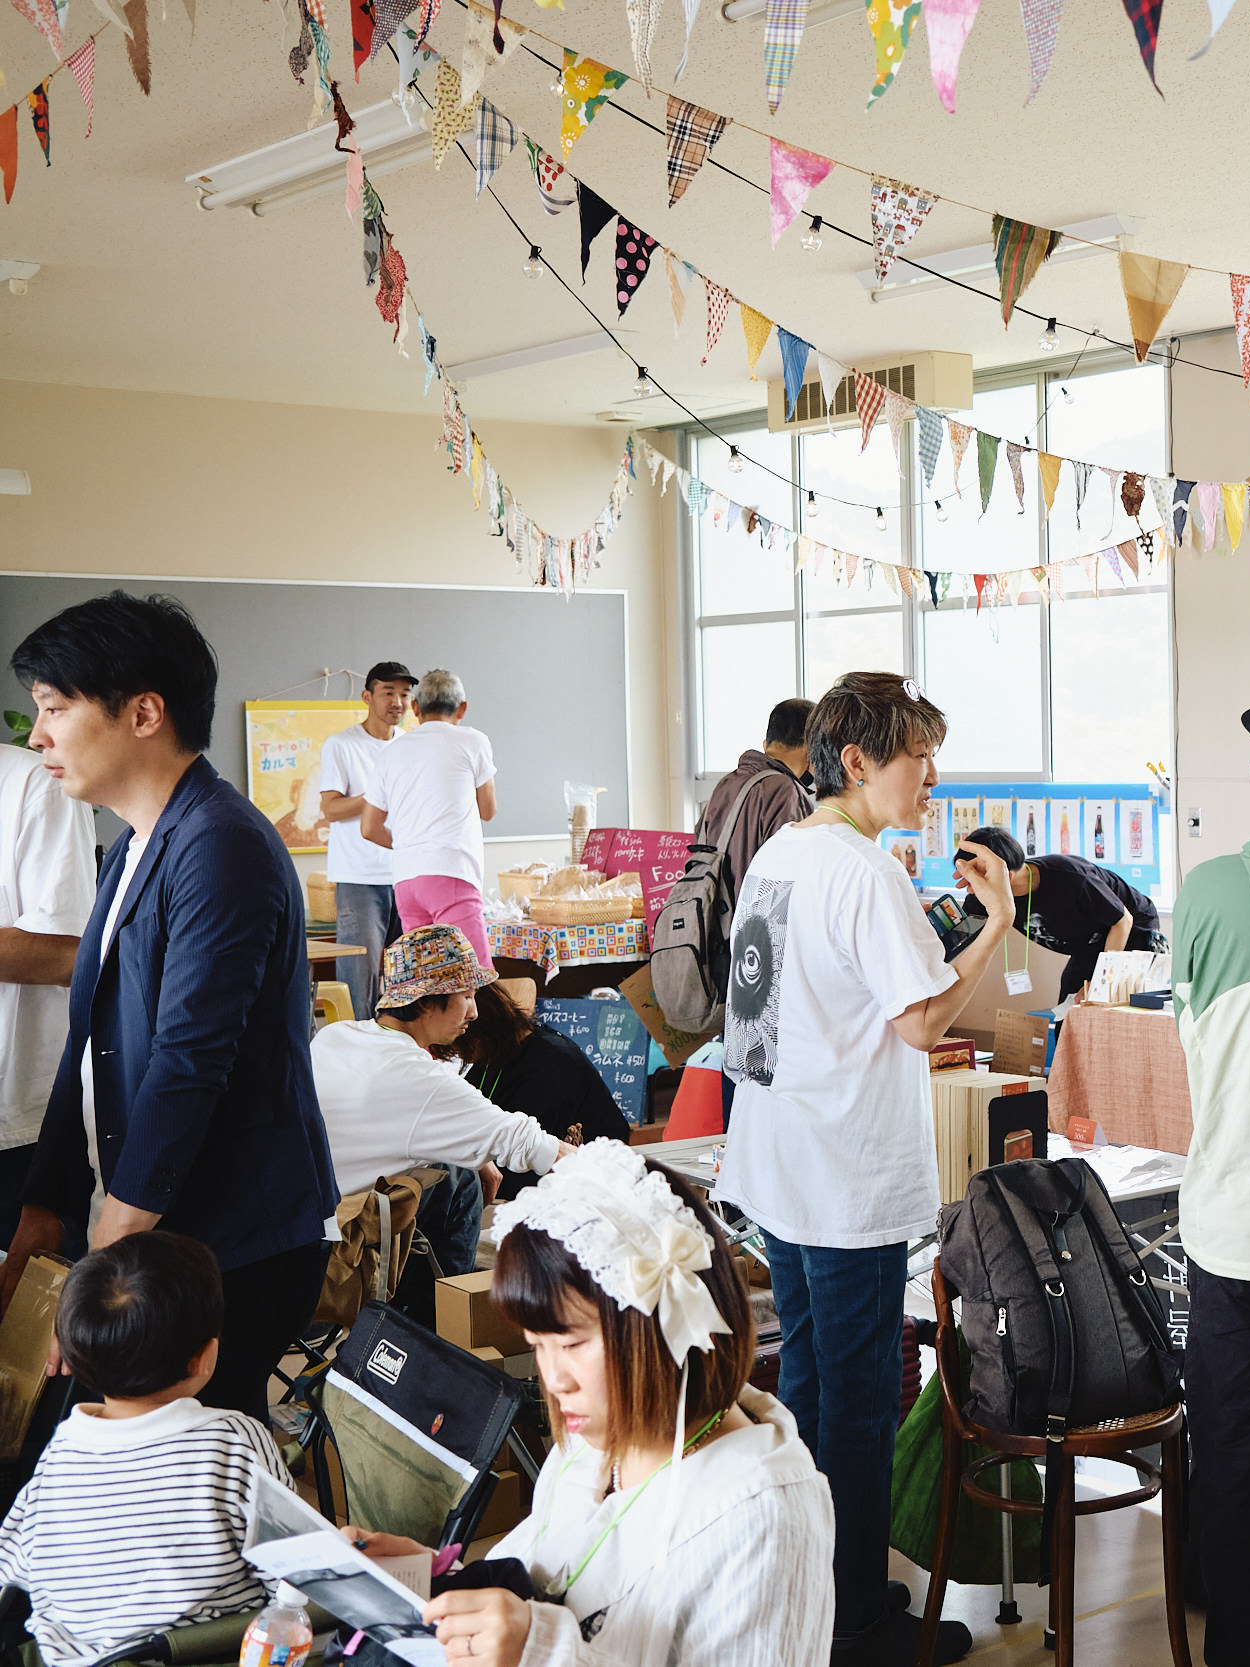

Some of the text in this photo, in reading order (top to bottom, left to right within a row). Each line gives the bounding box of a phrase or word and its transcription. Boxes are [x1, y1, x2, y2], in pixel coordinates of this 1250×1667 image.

[652, 865, 686, 882] Foo
[592, 1052, 624, 1068] ラムネ
